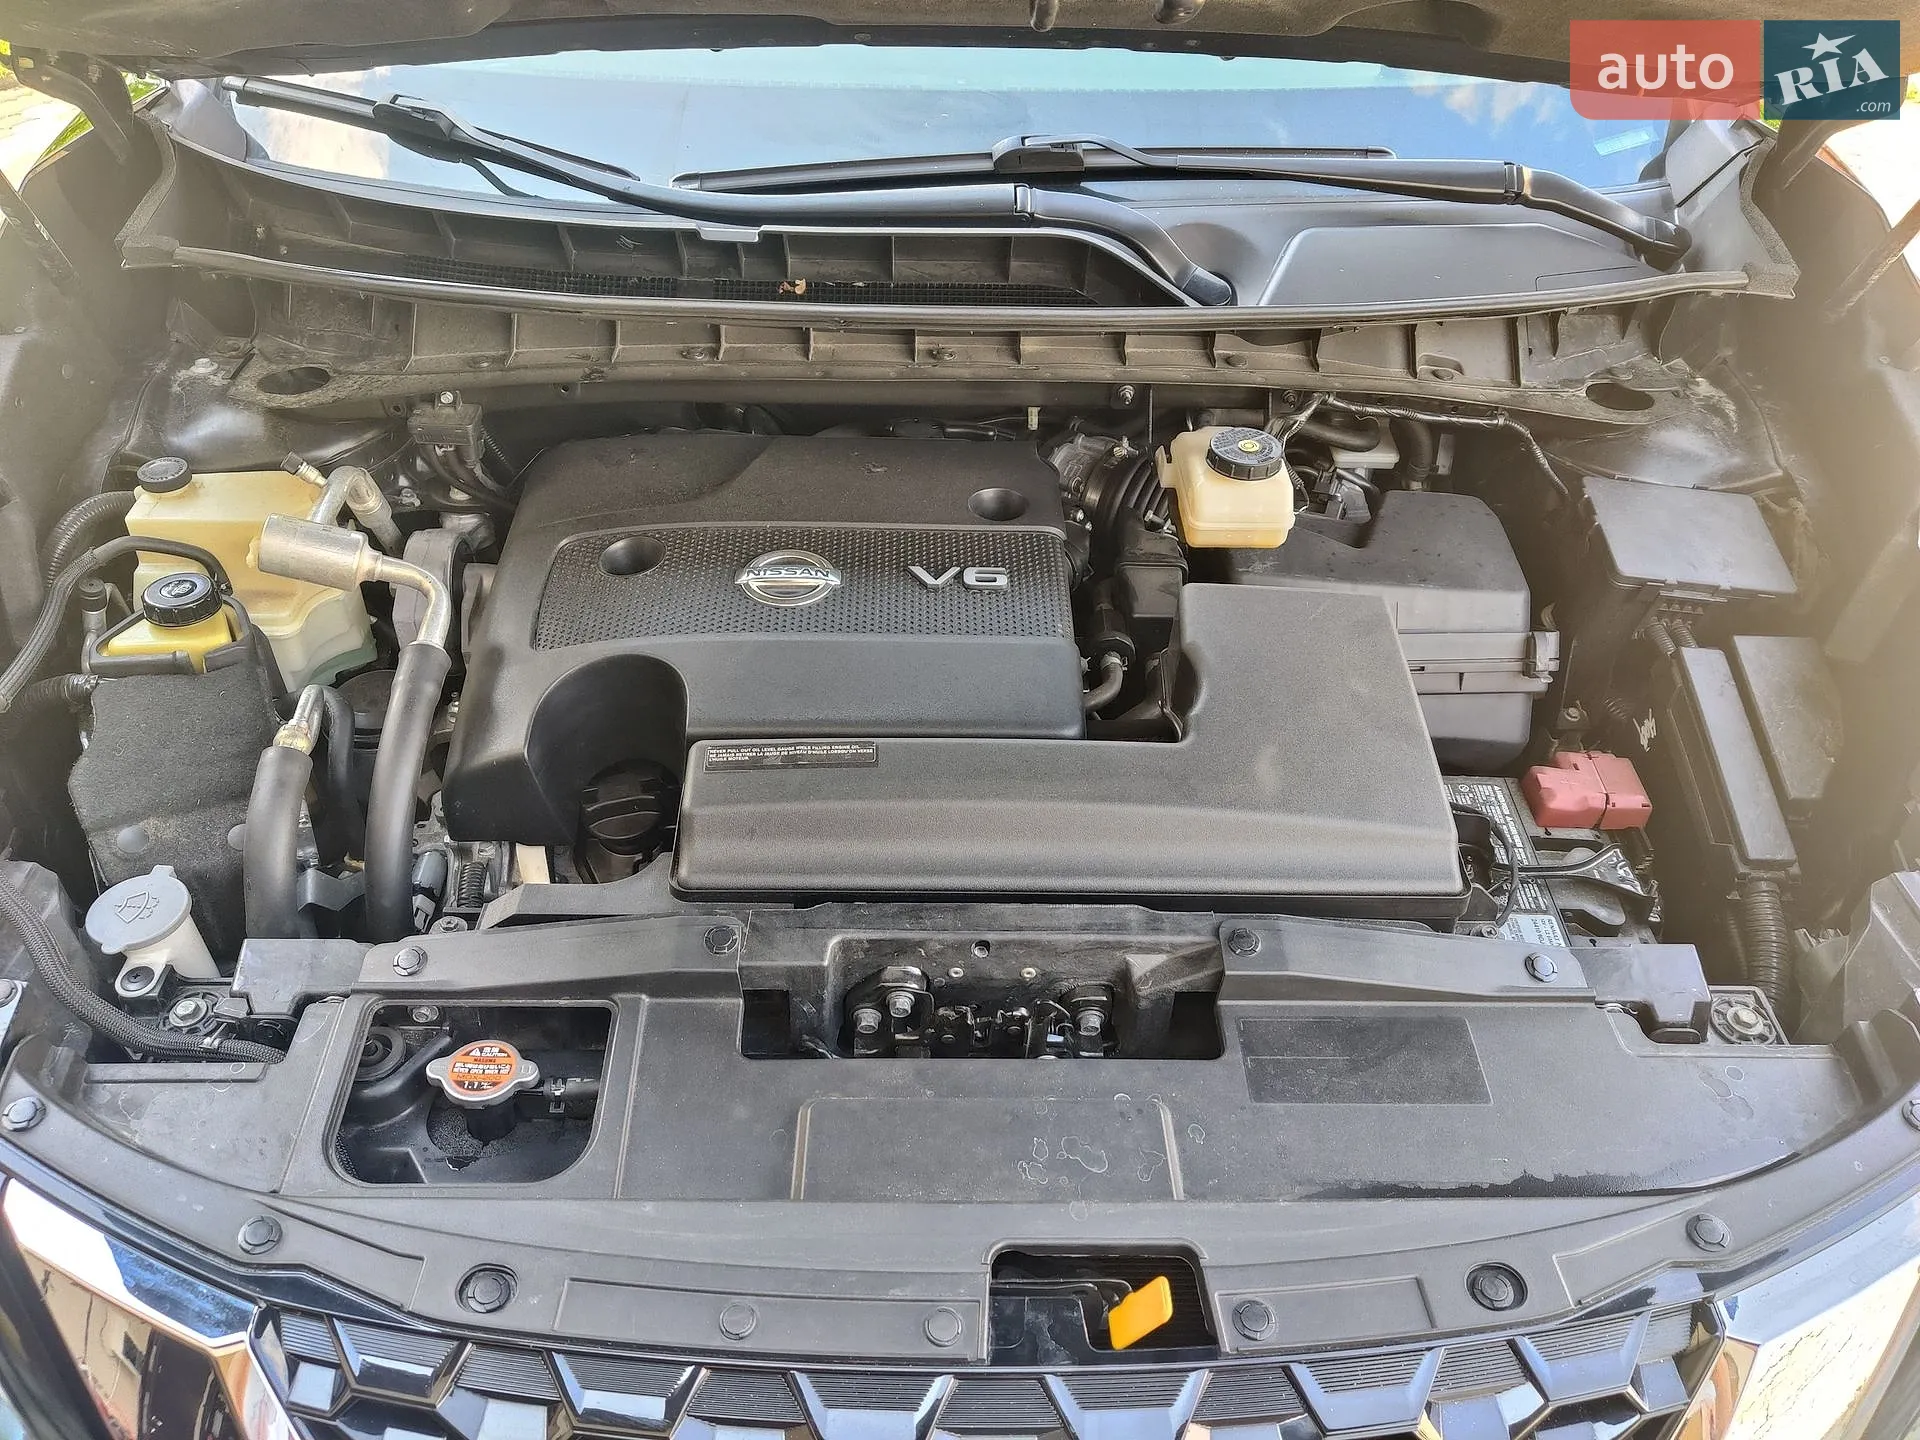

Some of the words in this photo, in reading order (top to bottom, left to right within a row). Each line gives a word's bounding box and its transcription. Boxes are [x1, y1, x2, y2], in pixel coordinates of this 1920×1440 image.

[746, 566, 830, 578] NISSAN
[908, 565, 1009, 591] V6
[464, 1081, 479, 1089] 1.1
